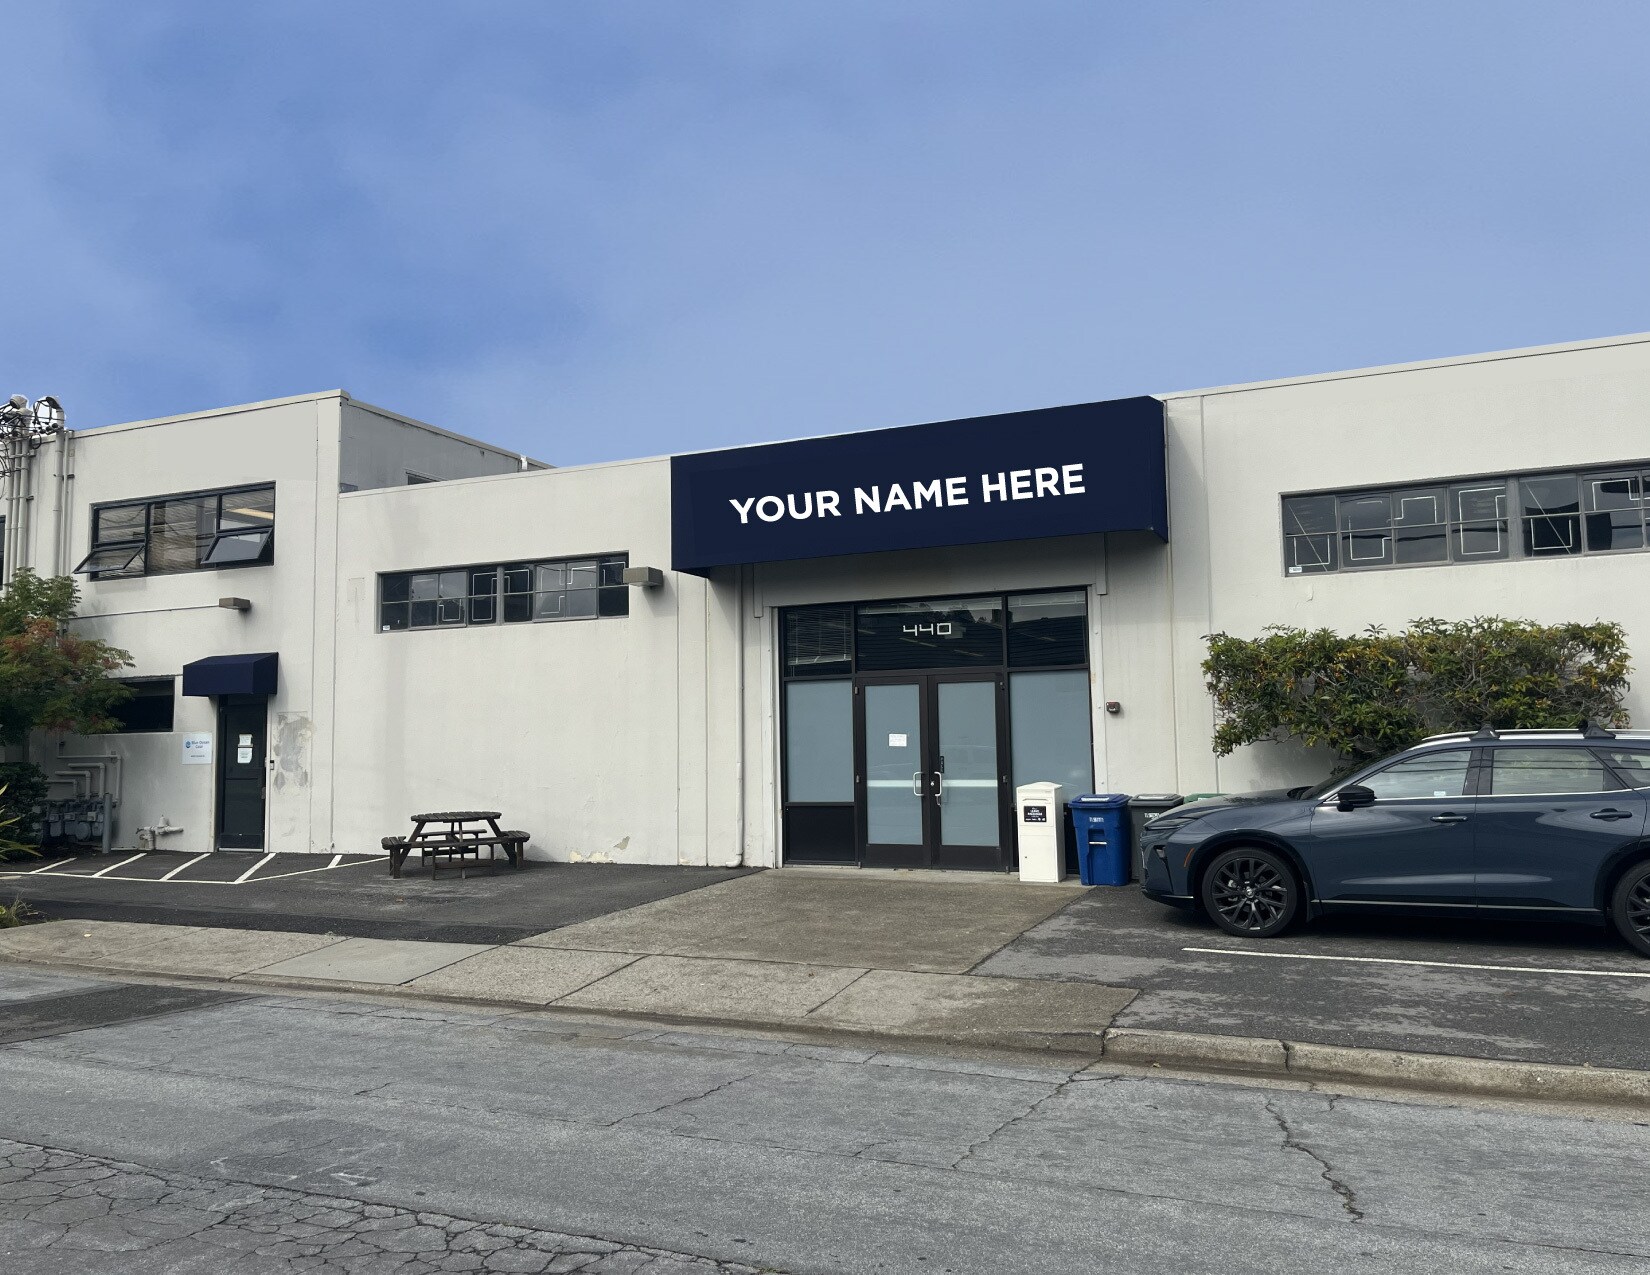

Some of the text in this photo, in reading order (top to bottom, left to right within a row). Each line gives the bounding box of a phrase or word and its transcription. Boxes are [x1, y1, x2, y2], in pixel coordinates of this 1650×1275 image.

[729, 463, 1086, 523] YOUR NAME HERE
[902, 622, 952, 637] 440
